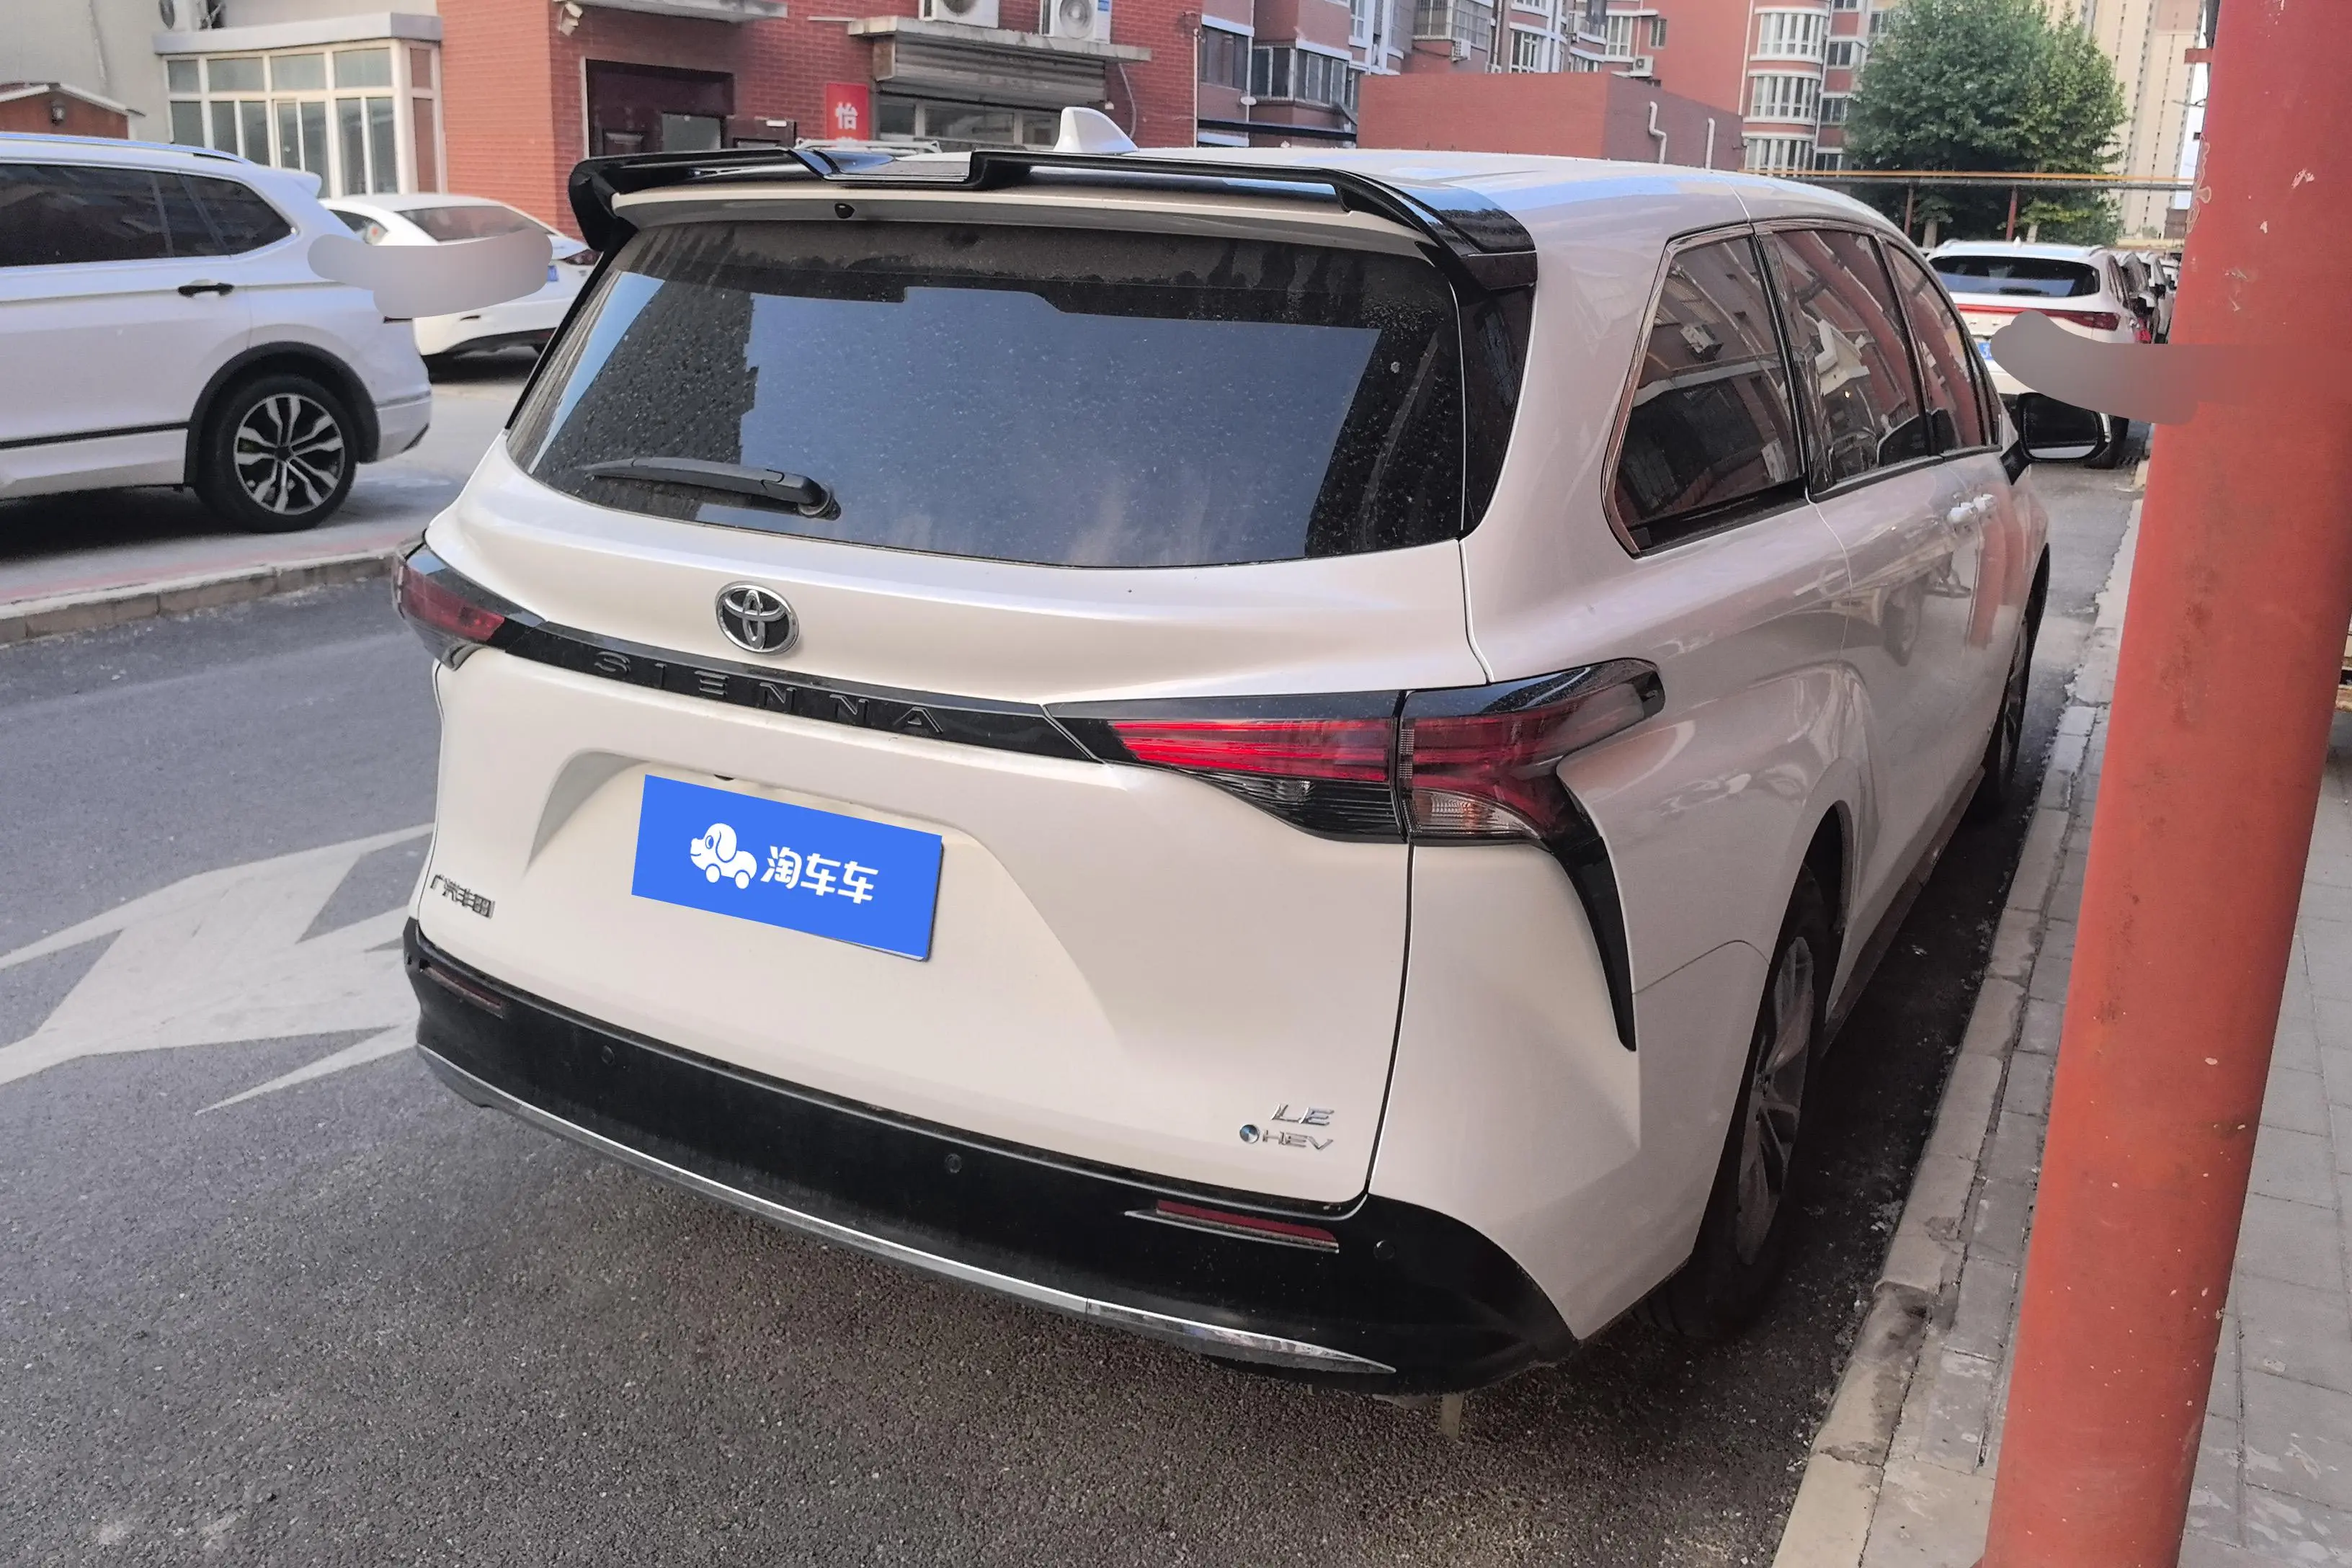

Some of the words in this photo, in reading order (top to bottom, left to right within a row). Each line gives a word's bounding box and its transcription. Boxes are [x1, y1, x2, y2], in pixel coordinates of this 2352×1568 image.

[835, 101, 858, 141] 怡
[594, 651, 943, 734] SIENNA
[430, 874, 495, 919] 广汽丰田
[1270, 1103, 1335, 1126] LE
[1262, 1129, 1334, 1152] HEV
